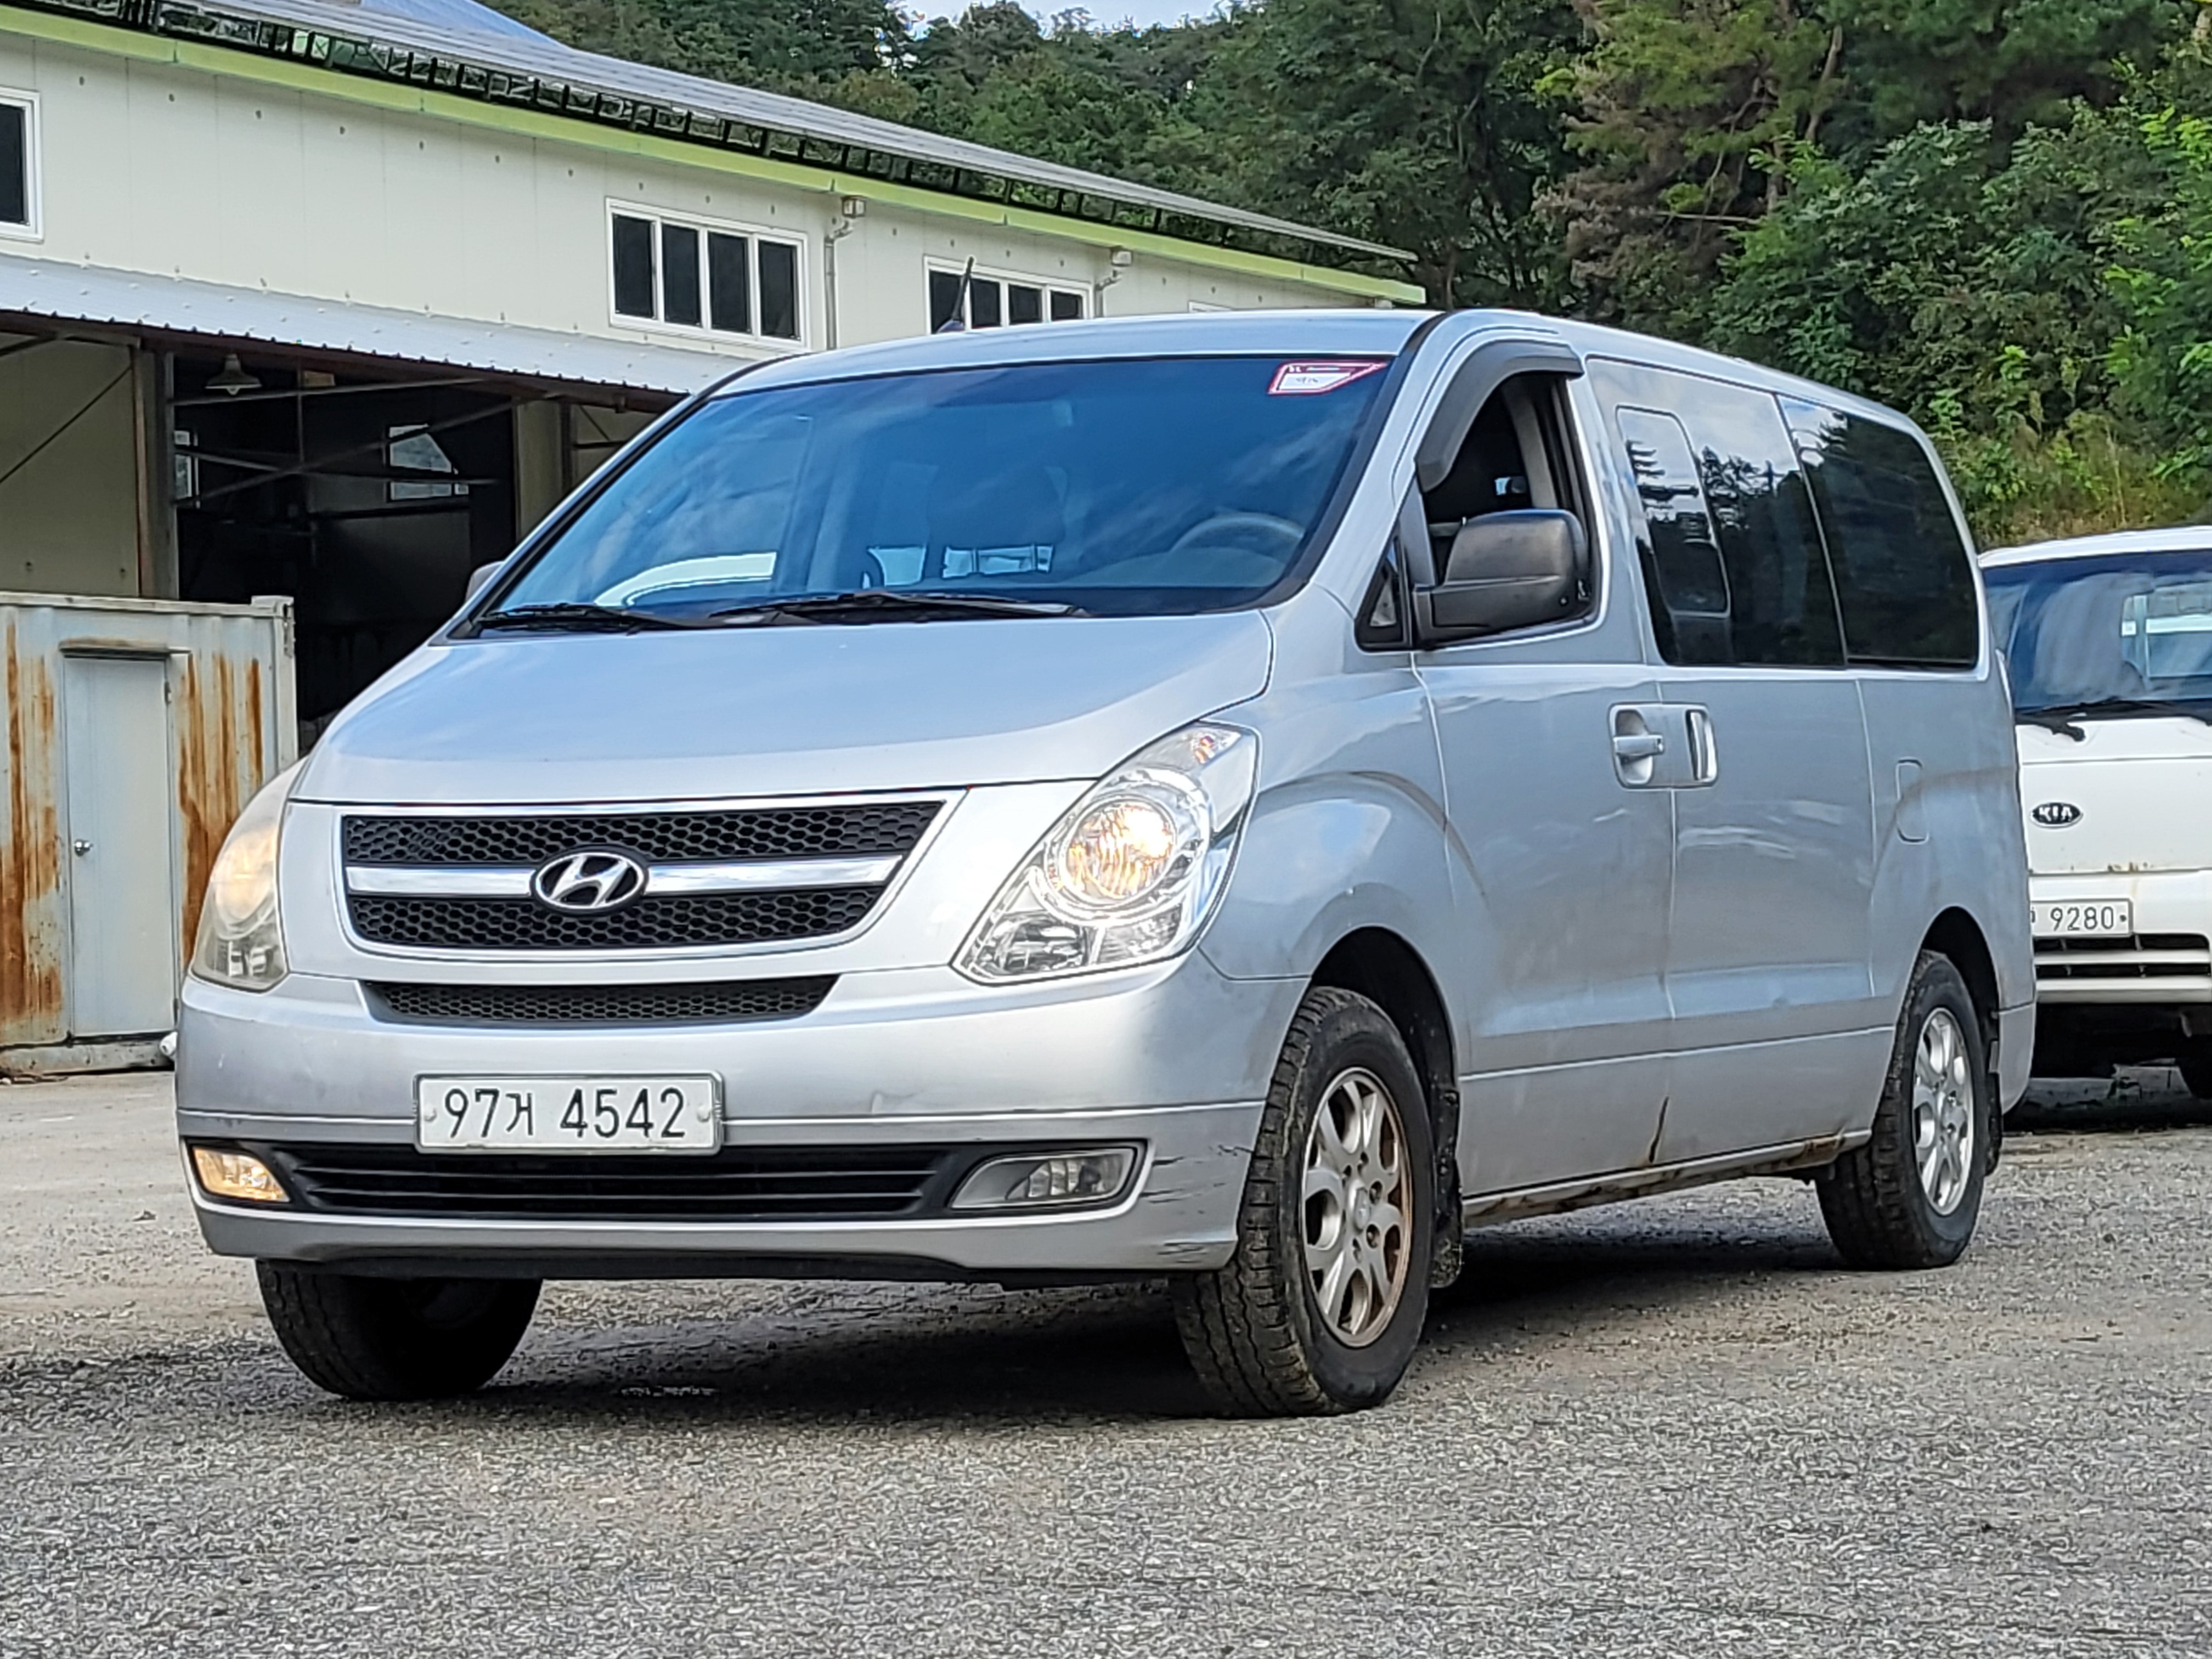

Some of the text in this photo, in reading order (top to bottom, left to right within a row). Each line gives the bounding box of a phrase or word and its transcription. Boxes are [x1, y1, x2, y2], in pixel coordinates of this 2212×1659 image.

[2039, 805, 2073, 822] KIA
[2050, 906, 2114, 932] 9280
[444, 1088, 685, 1138] 97거 4542
